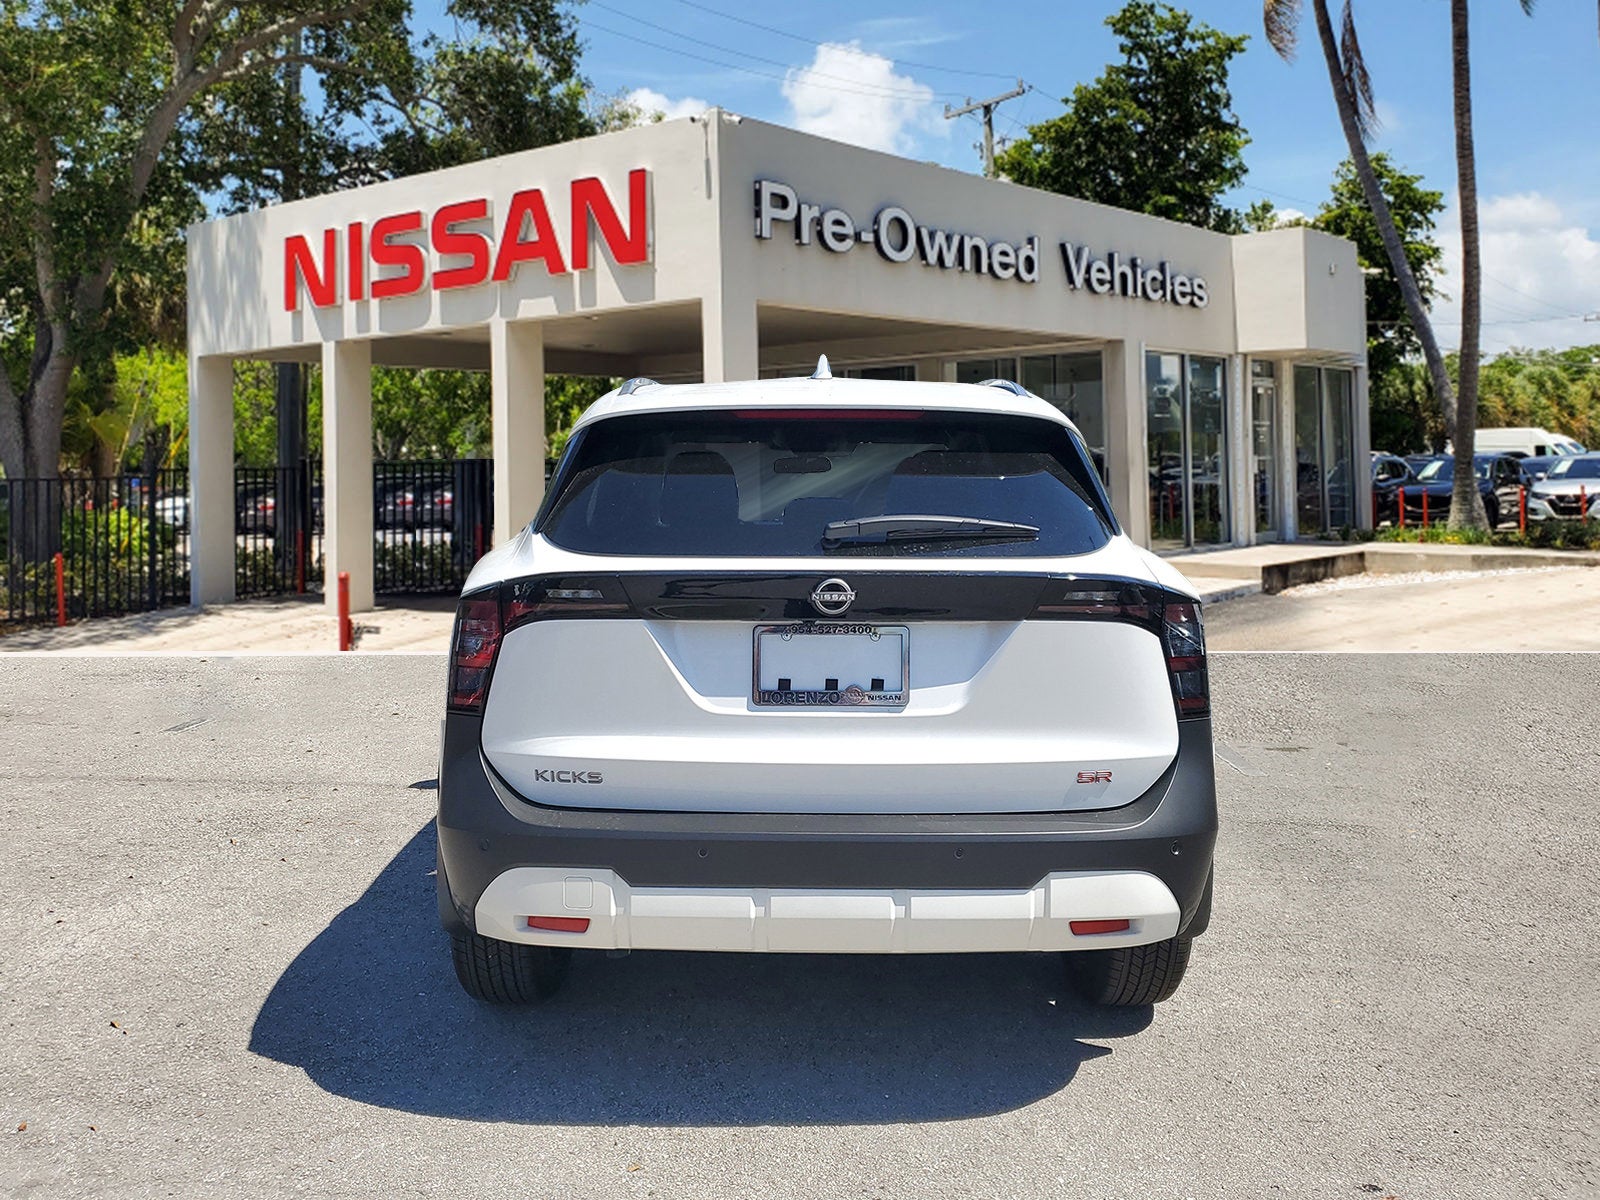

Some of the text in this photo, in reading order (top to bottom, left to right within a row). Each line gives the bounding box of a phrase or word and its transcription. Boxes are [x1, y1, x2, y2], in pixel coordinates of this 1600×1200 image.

[285, 168, 648, 312] NISSAN
[754, 179, 1209, 308] Pre-Owned Vehicles
[812, 592, 855, 601] NISSAN
[761, 691, 840, 704] LORENZO
[534, 768, 603, 784] KICKS
[1077, 770, 1112, 783] SR
